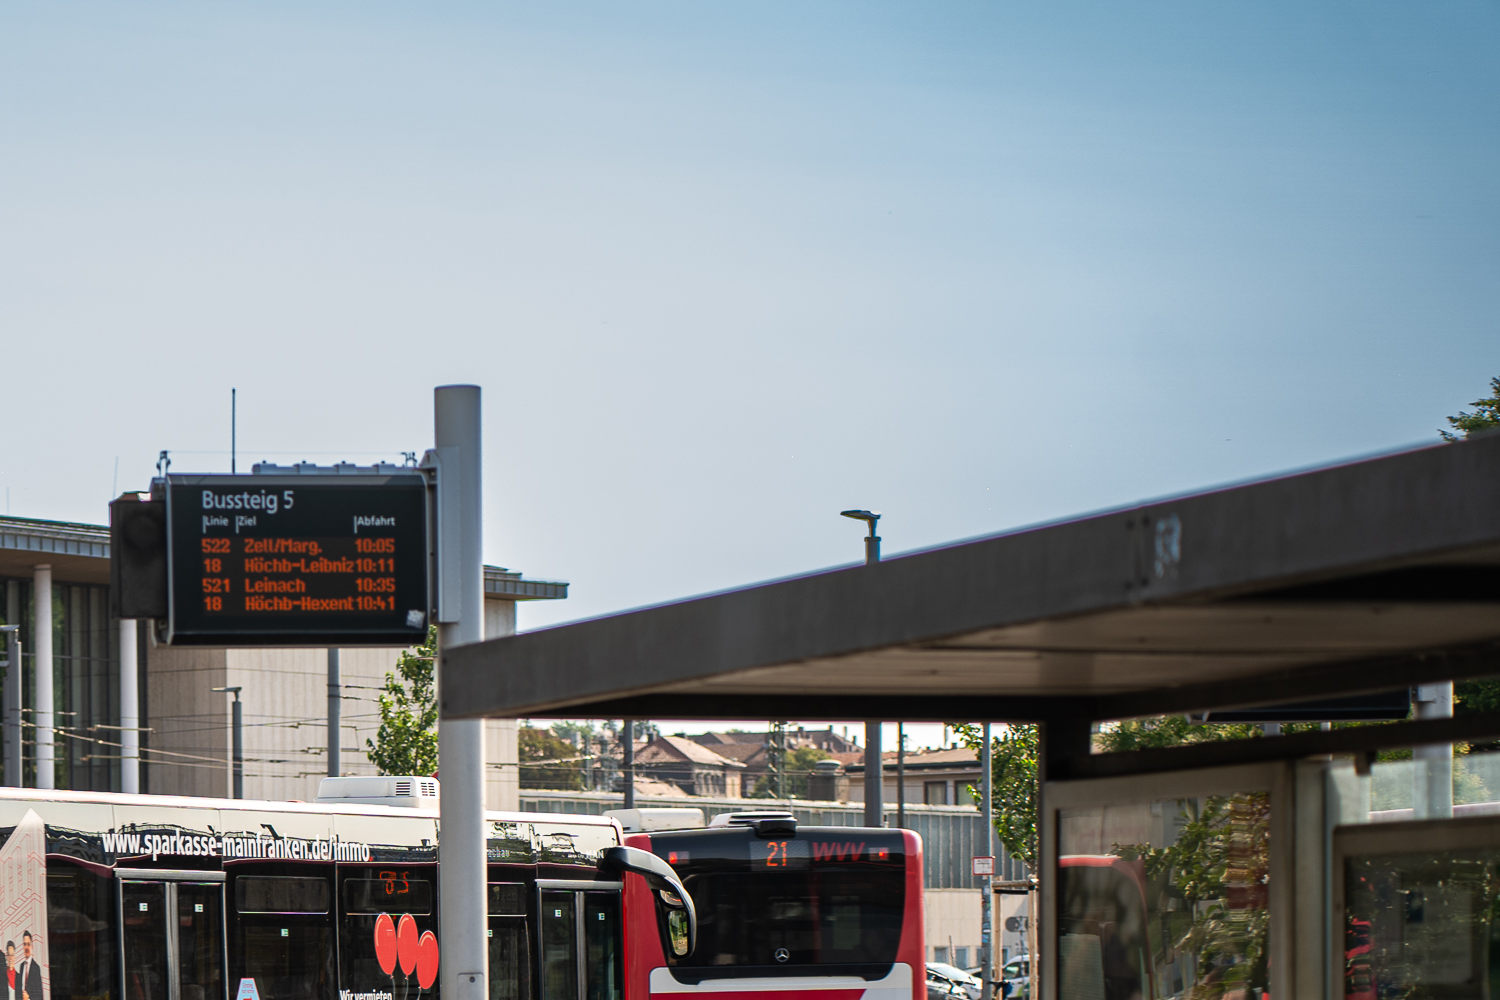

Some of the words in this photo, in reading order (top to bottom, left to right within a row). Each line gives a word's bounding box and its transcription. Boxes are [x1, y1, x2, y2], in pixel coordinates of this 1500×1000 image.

[202, 489, 278, 514] Bussteig
[283, 490, 294, 509] 5
[205, 516, 229, 526] Linie
[238, 516, 256, 526] Ziel
[357, 516, 396, 526] Abfahrt
[202, 538, 230, 553] 522
[244, 538, 323, 556] Zell/Marg.
[355, 538, 395, 553] 10:05
[204, 558, 221, 573] 18
[245, 556, 354, 573] Höchb-Leibniz
[355, 558, 394, 573] 10:11
[202, 578, 230, 593] 521
[245, 577, 306, 593] Leinach
[356, 578, 395, 593] 10:35
[204, 596, 222, 611] 18
[245, 595, 354, 611] Höchb-Hexent
[356, 596, 395, 611] 10:41
[766, 841, 787, 866] 21
